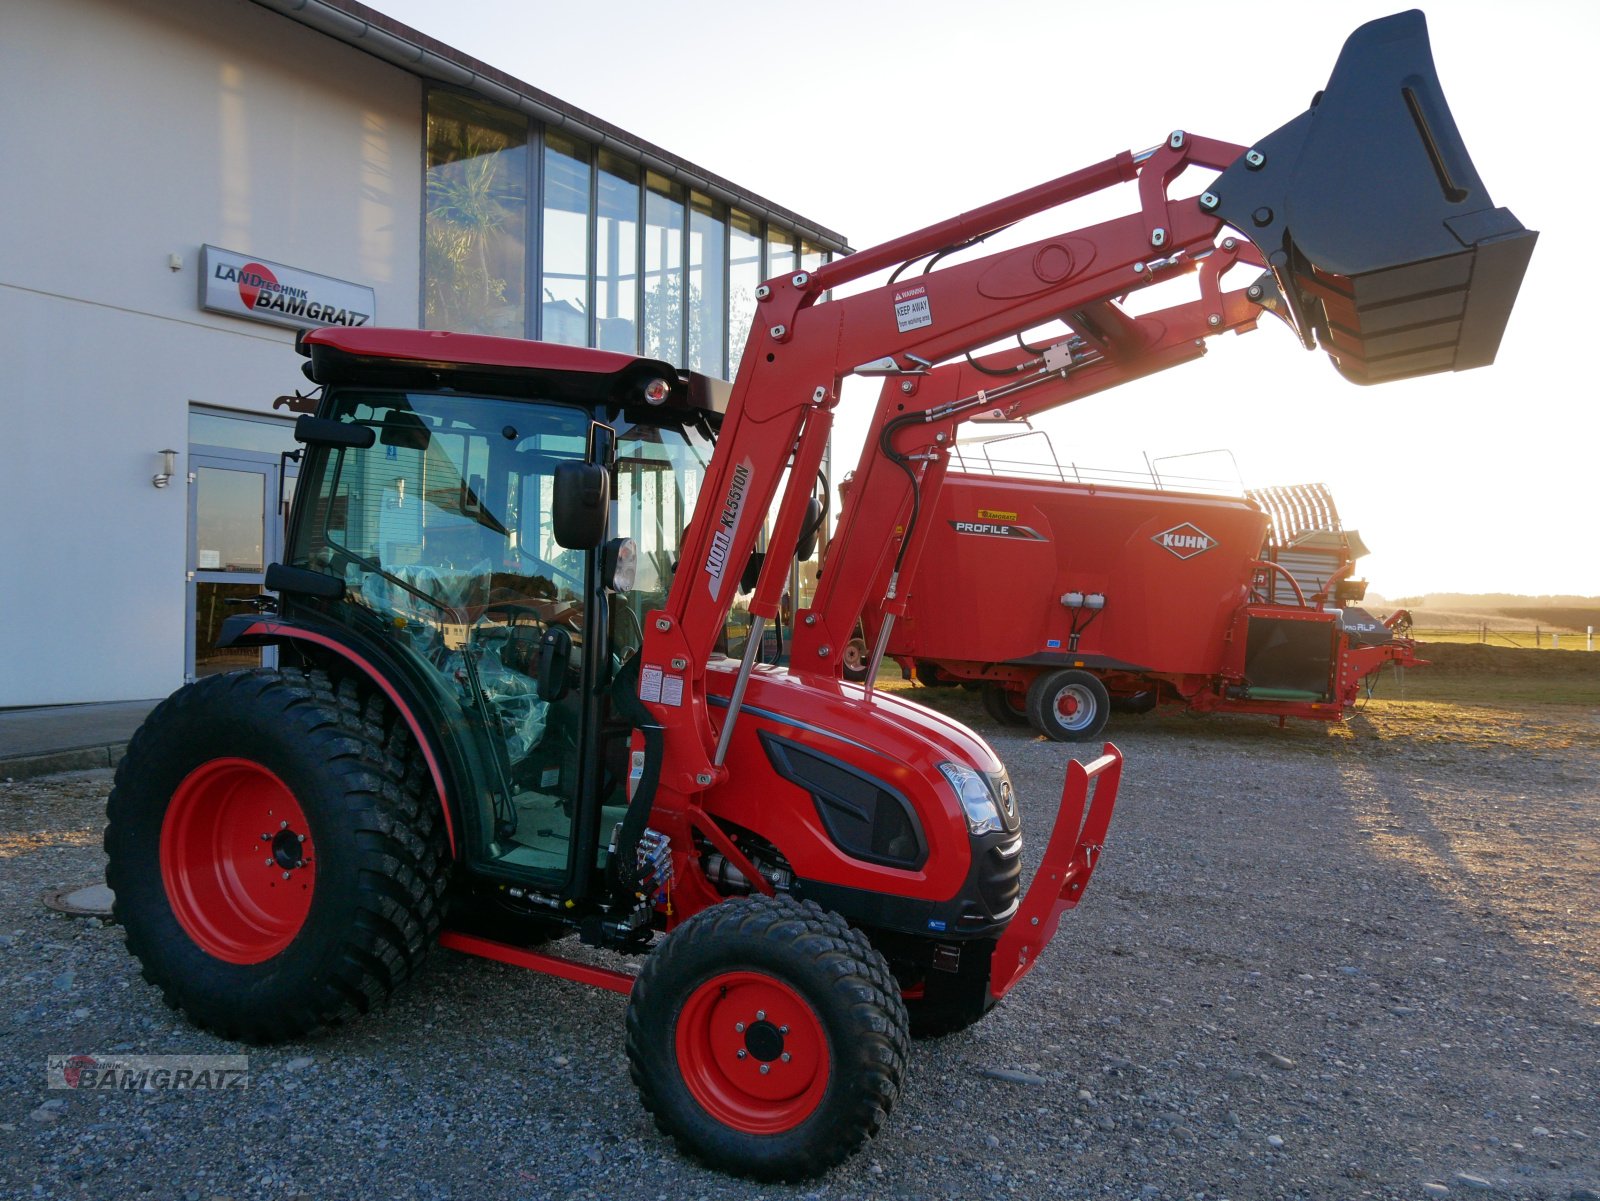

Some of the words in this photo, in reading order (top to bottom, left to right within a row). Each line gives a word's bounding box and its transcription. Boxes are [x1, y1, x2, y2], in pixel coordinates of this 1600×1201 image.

[255, 289, 370, 327] BAMGRATZ
[897, 305, 911, 317] KEEP
[912, 300, 927, 313] AWAY
[720, 464, 749, 529] KL5510N
[956, 522, 1009, 535] PROFILE
[1163, 533, 1208, 549] KUHN
